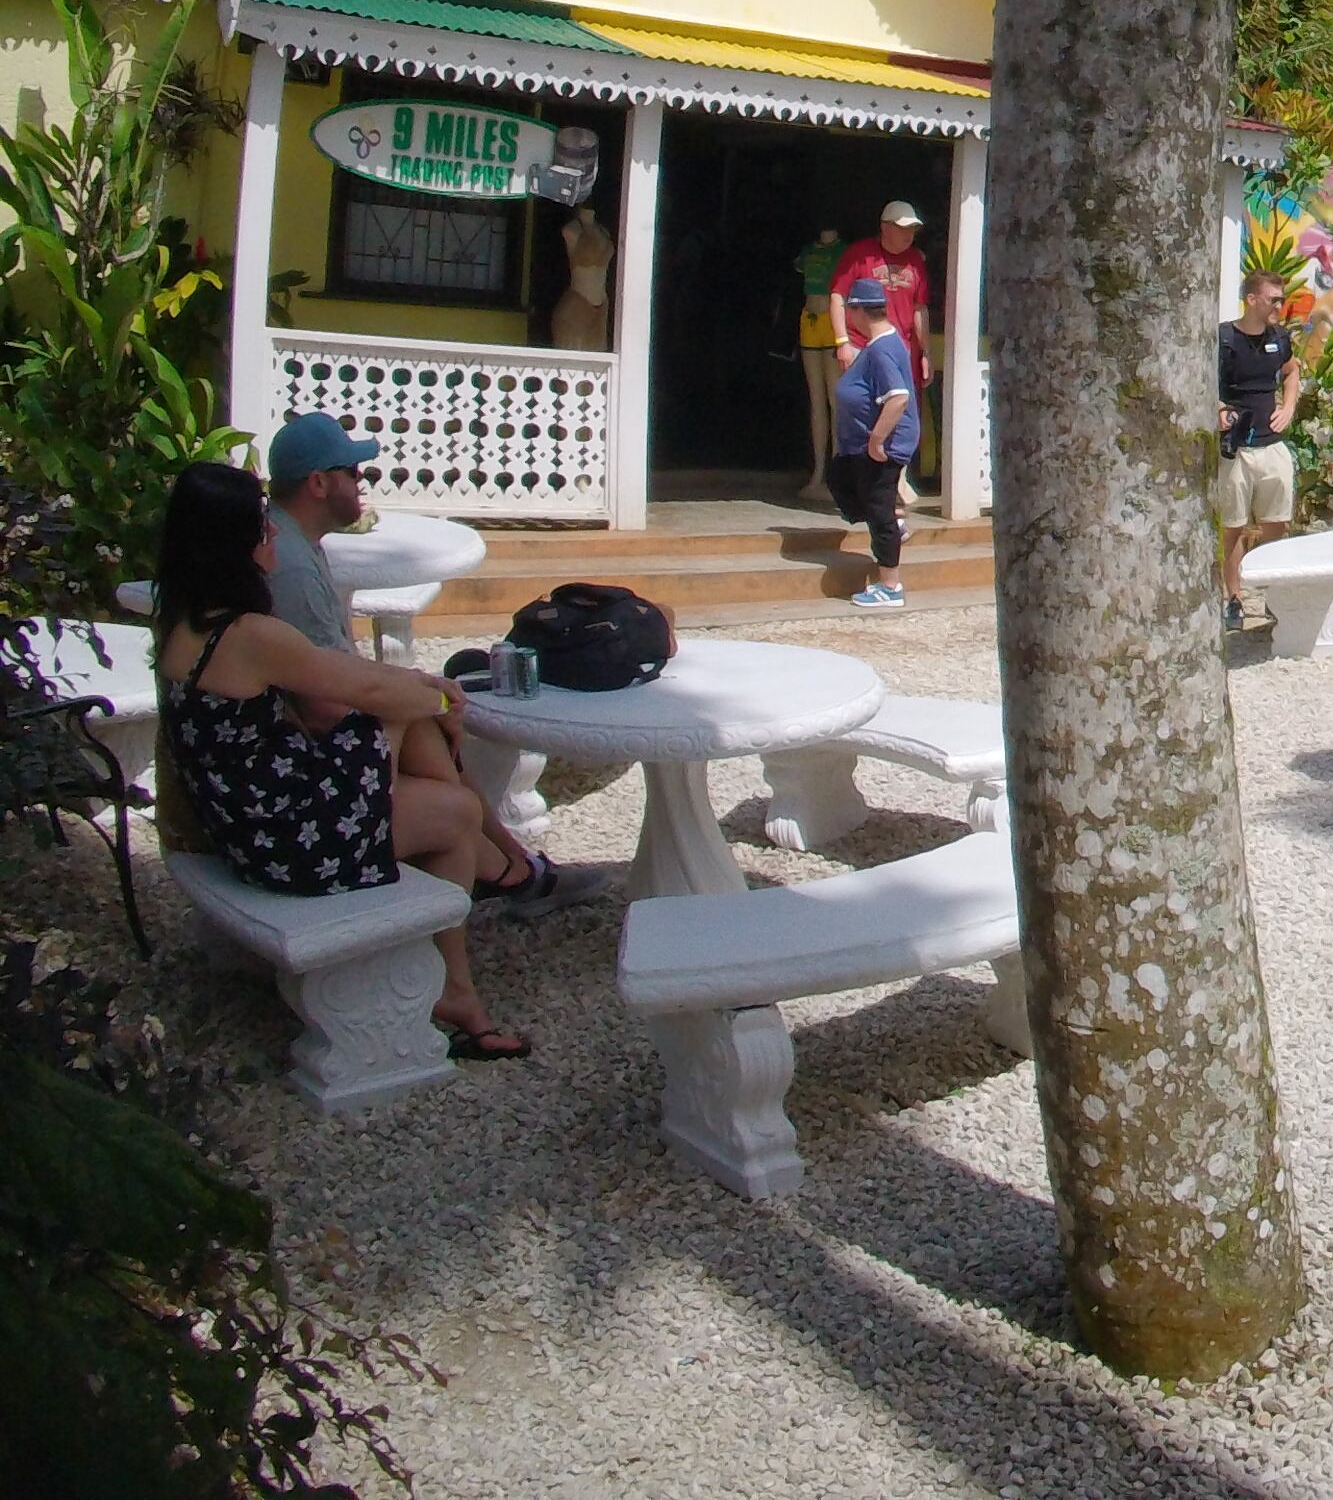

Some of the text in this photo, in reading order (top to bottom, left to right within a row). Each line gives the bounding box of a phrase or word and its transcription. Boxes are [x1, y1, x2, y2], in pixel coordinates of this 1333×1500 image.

[393, 106, 519, 163] 9 MILES
[391, 153, 515, 193] TRADING POST
